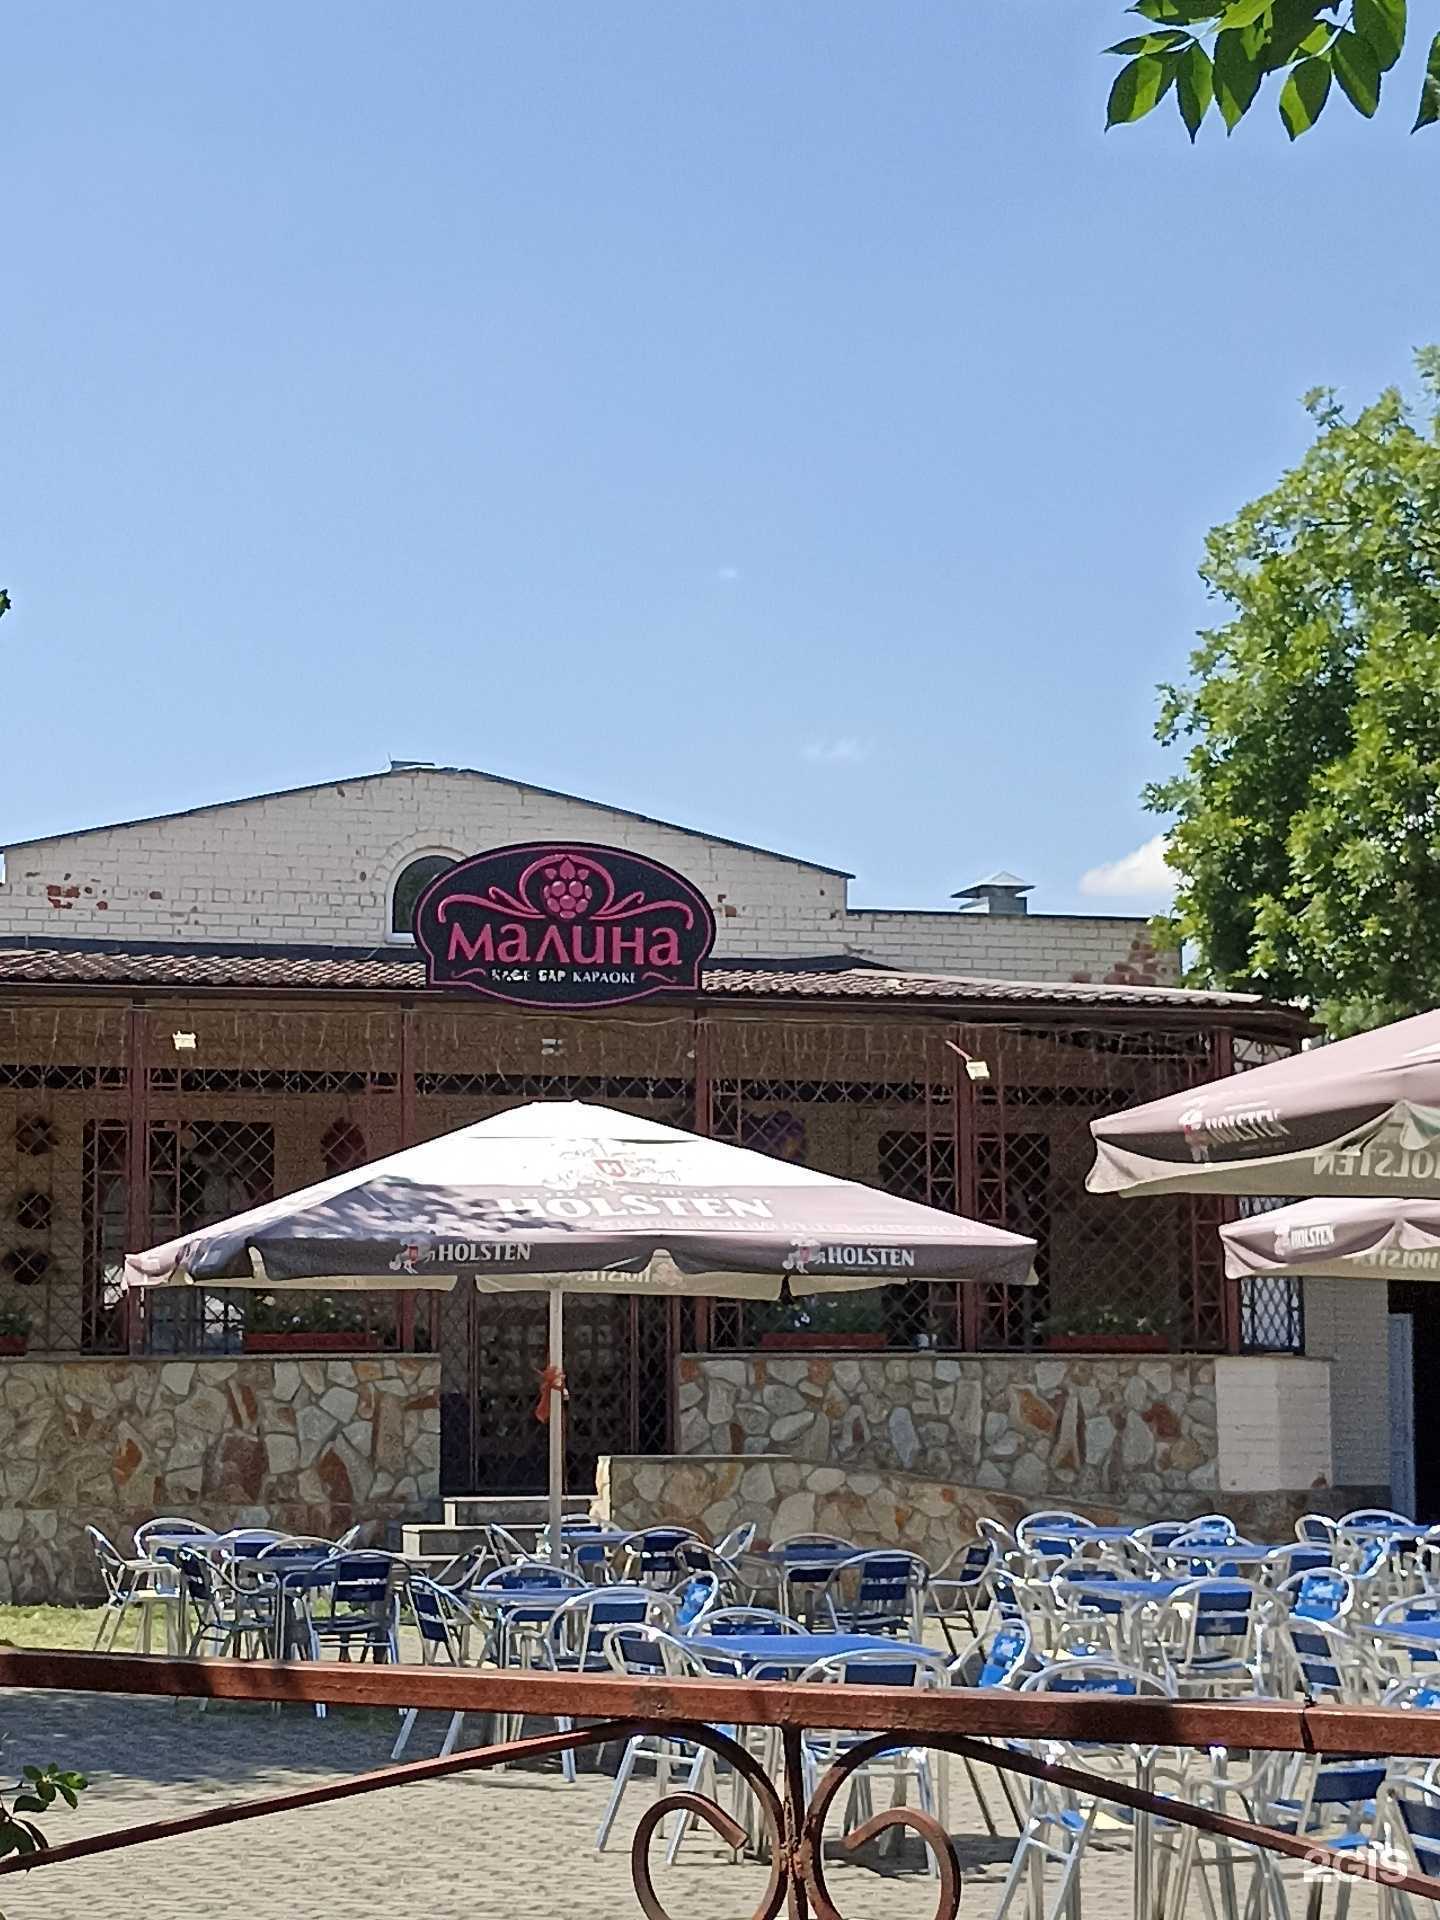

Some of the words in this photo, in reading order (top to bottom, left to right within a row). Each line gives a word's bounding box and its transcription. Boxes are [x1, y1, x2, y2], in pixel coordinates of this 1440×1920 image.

[537, 969, 566, 983] БАР
[499, 1194, 774, 1219] HOLSTEN
[438, 1242, 533, 1263] HOLSTEN
[827, 1246, 915, 1267] HOLSTEN
